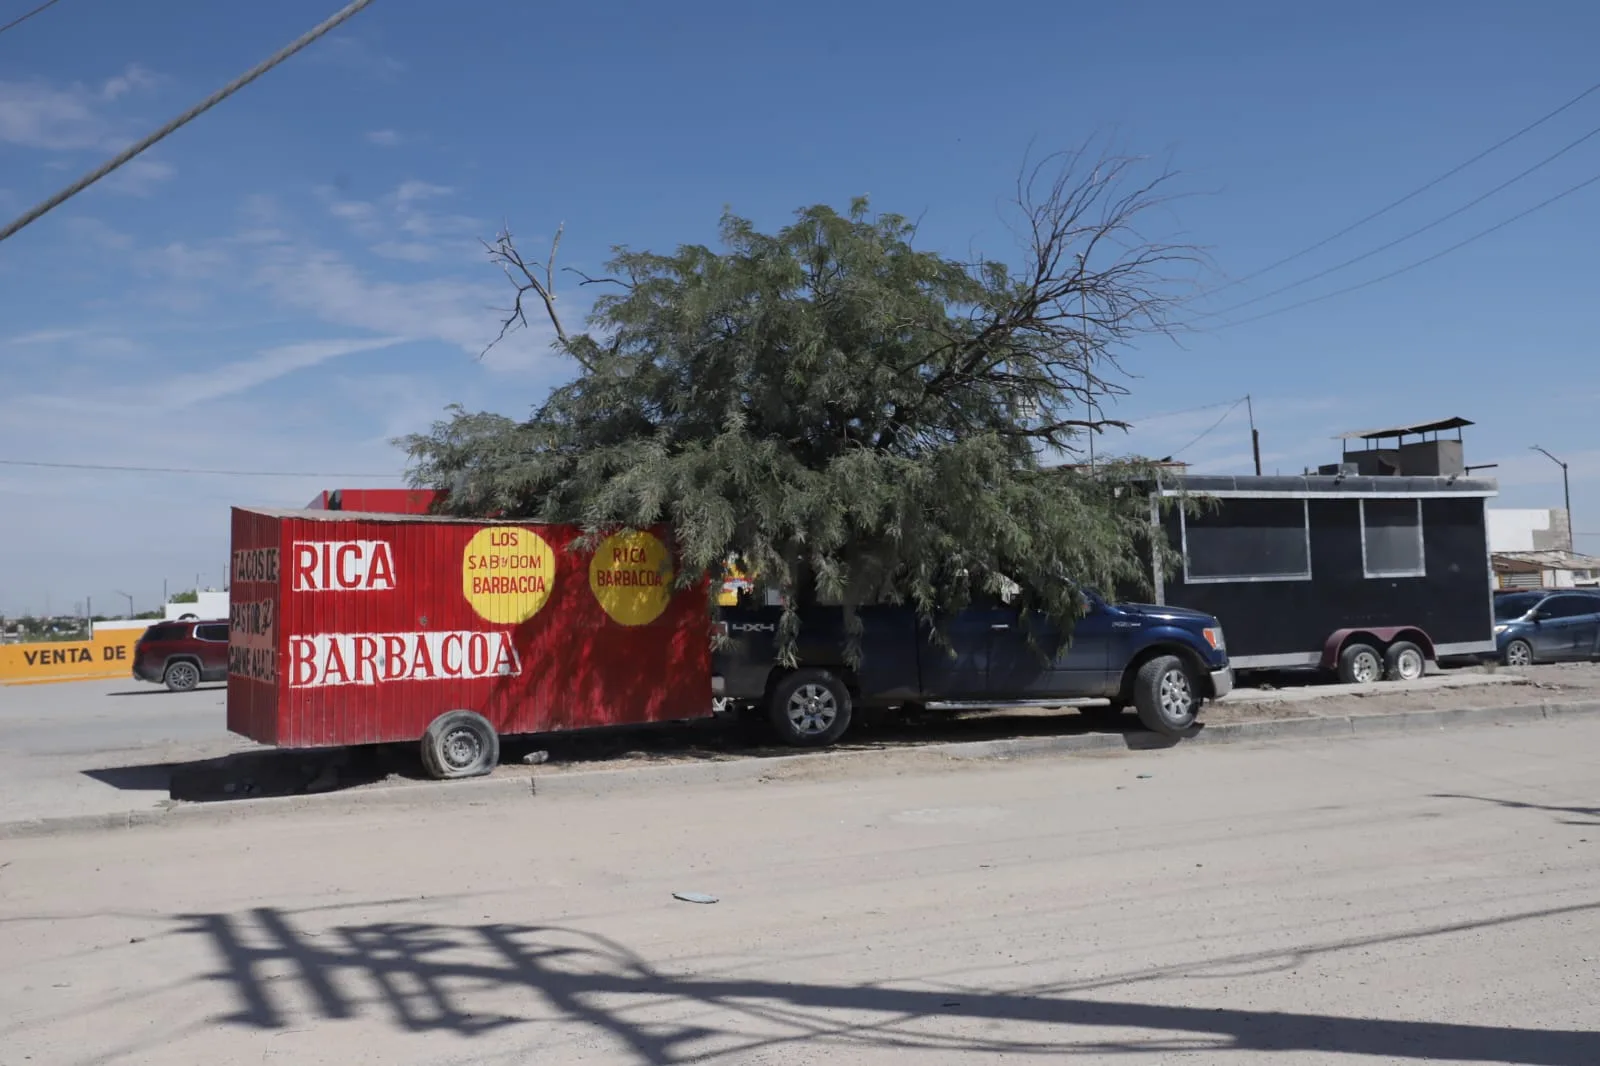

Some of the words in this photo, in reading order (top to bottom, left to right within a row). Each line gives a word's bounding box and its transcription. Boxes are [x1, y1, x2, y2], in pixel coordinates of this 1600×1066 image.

[491, 532, 518, 546] LOS
[468, 555, 500, 569] SAB
[510, 555, 541, 568] DOM
[613, 547, 646, 563] RICA
[232, 550, 264, 580] TACOS
[266, 549, 277, 580] DE
[293, 543, 394, 589] RICA
[473, 576, 545, 593] BARBACOA
[597, 570, 663, 586] BARBACOA
[23, 647, 93, 666] VENTA
[103, 645, 127, 661] DE
[289, 632, 520, 686] BARBACOA
